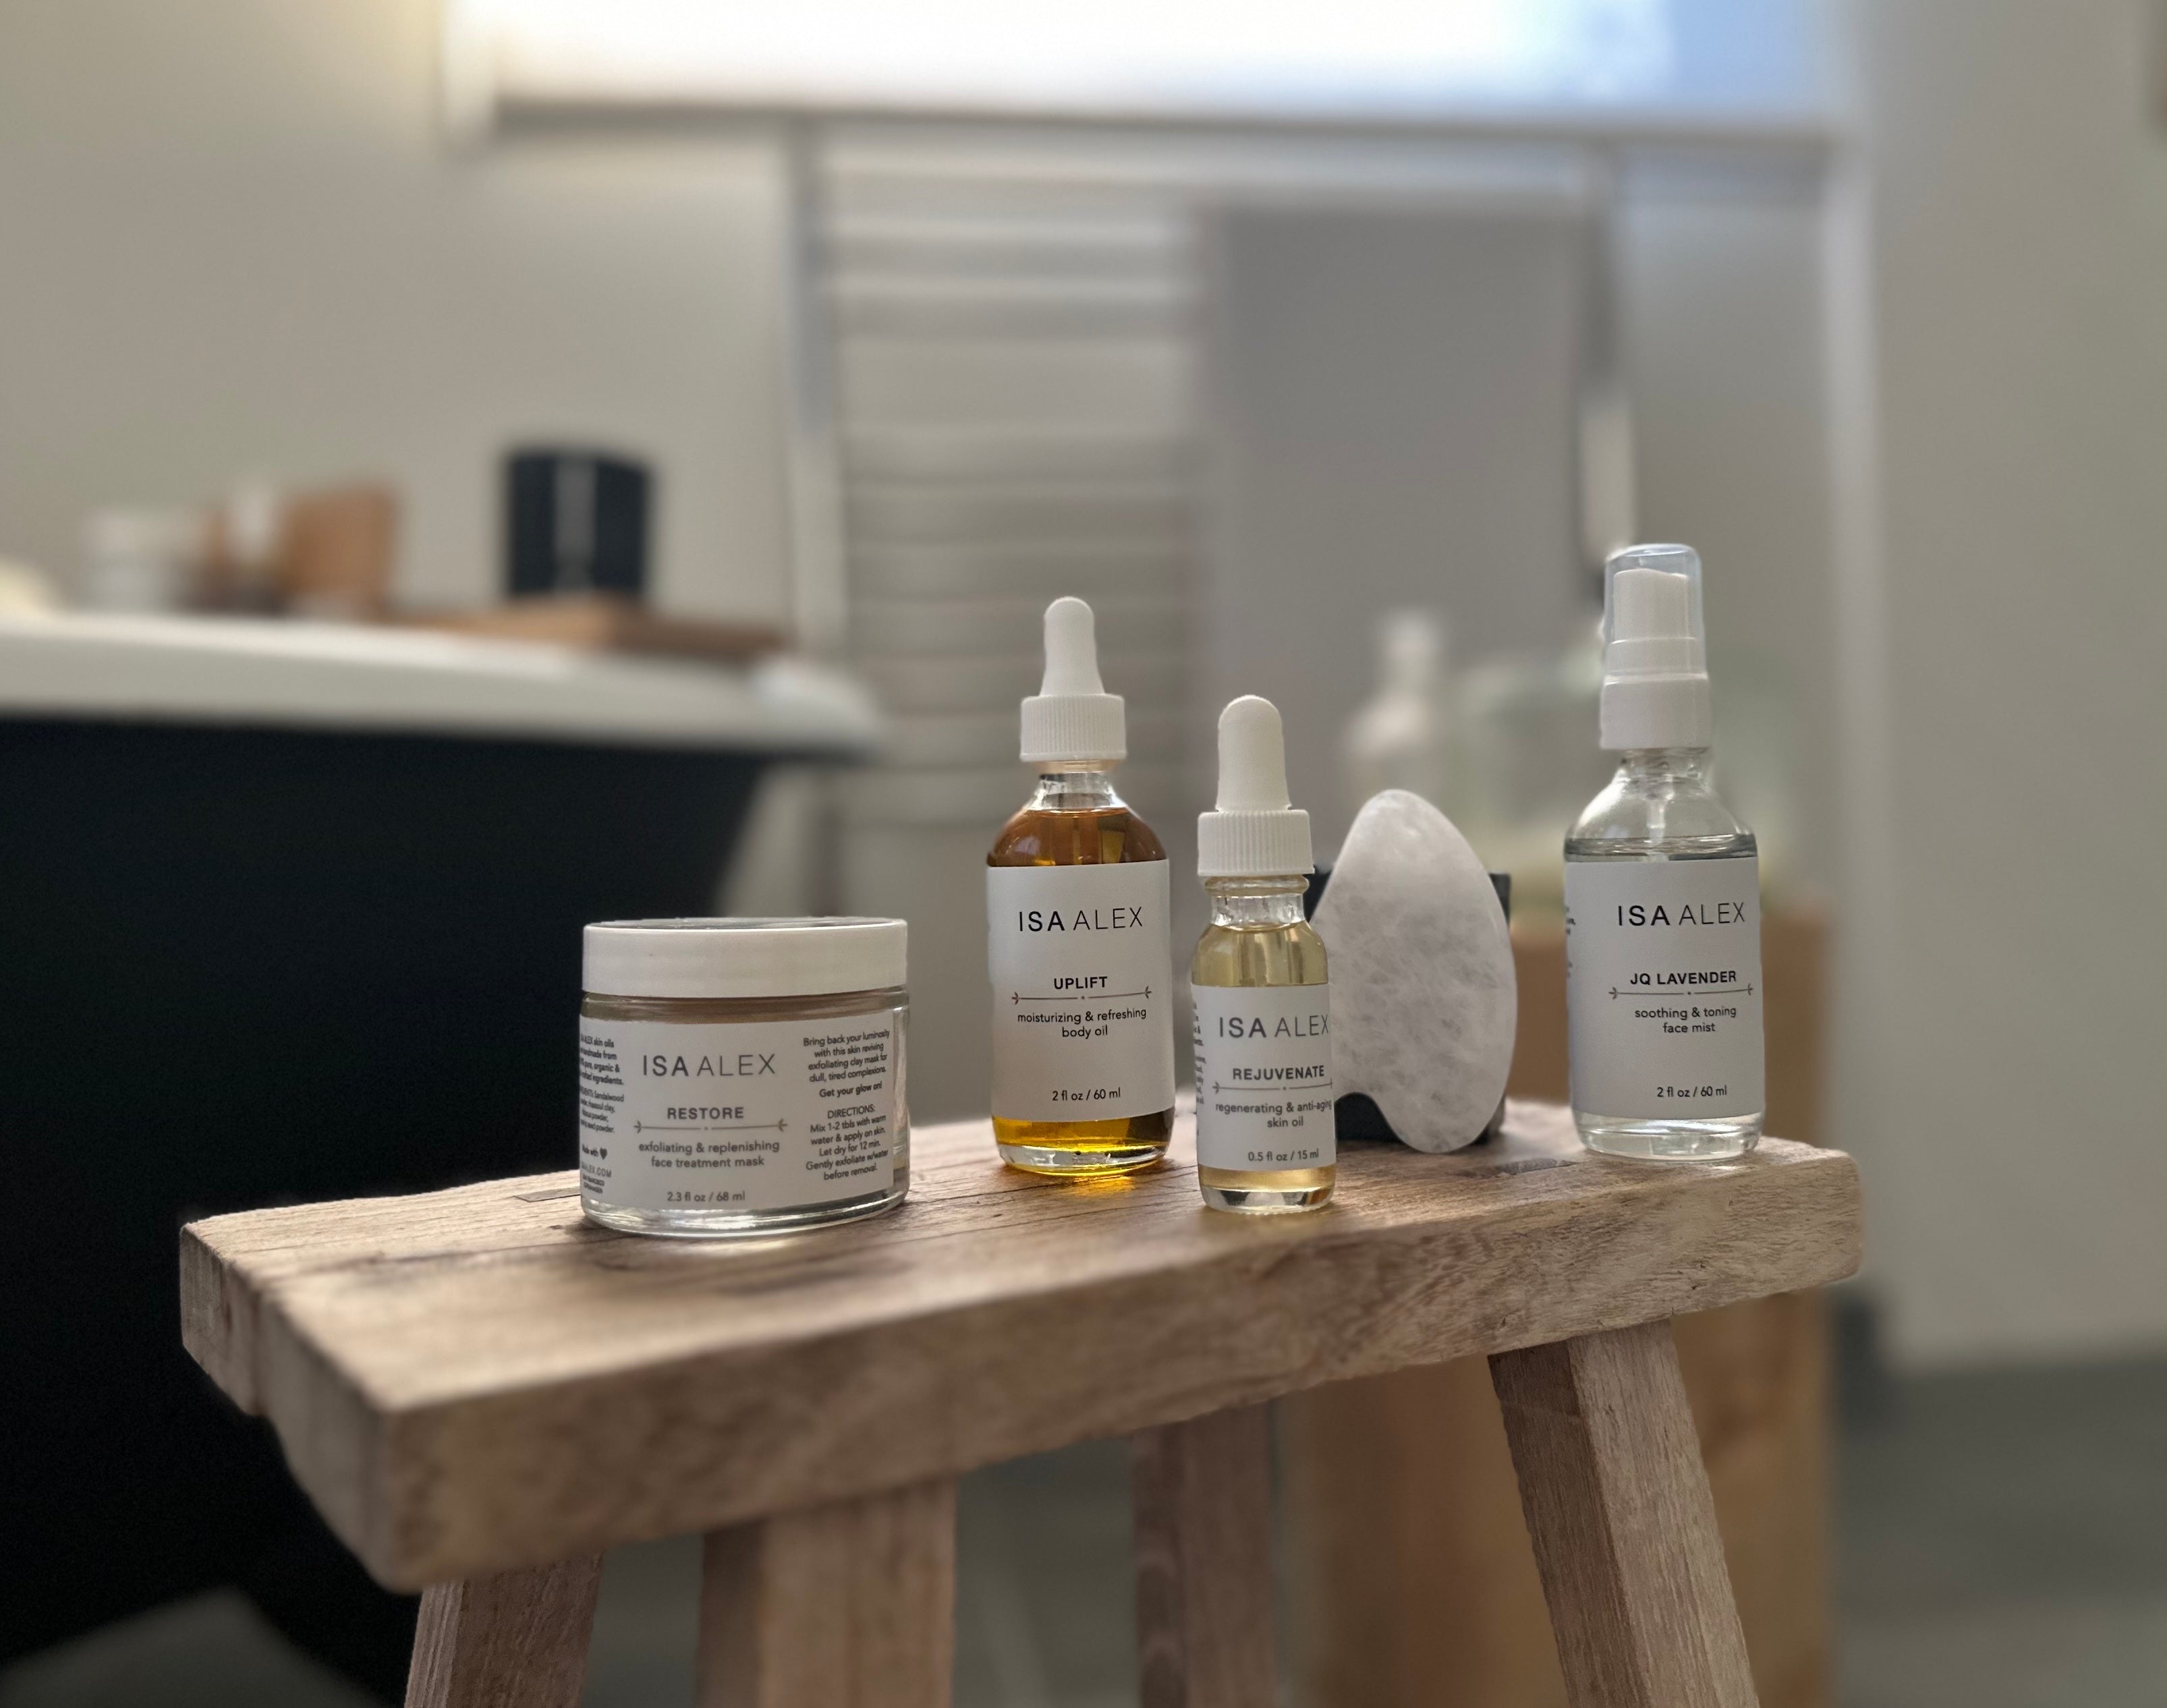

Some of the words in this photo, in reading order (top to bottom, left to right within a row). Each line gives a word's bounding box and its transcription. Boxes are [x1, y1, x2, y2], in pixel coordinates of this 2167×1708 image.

[1019, 911, 1065, 932] ISA
[1073, 906, 1144, 931] ALEX
[1618, 905, 1670, 927] ISA
[1679, 902, 1746, 926] ALEX
[1053, 976, 1108, 990] UPLIFT
[1630, 973, 1652, 986] JQ
[1657, 970, 1737, 985] LAVENDER
[1017, 1012, 1081, 1024] moisturizing
[1085, 1011, 1094, 1022] &
[1097, 1008, 1147, 1021] refreshing
[1635, 1007, 1688, 1021] soothing
[1691, 1007, 1701, 1018] &
[1704, 1006, 1737, 1018] toning
[1062, 1027, 1092, 1040] body
[1094, 1025, 1108, 1036] oil
[1219, 1017, 1266, 1037] ISA
[1274, 1014, 1329, 1037] ALEX
[1663, 1022, 1688, 1033] face
[1692, 1021, 1716, 1033] mist
[804, 1037, 825, 1047] Bring
[827, 1034, 845, 1044] back
[847, 1035, 862, 1044] your
[863, 1029, 890, 1040] luminosity
[814, 1048, 831, 1058] with
[833, 1047, 845, 1056] this
[847, 1046, 860, 1054] skin
[862, 1043, 884, 1052] reviving
[594, 1062, 614, 1073] organic
[615, 1064, 620, 1073] &
[643, 1055, 689, 1077] ISA
[697, 1053, 775, 1077] ALEX
[808, 1059, 849, 1070] exfoliating
[851, 1058, 863, 1067] clay
[865, 1054, 879, 1063] mask
[810, 1073, 826, 1082] dull,
[828, 1070, 846, 1081] tired
[1233, 1065, 1325, 1081] REJUVENATE
[820, 1089, 835, 1097] Get
[837, 1087, 854, 1098] your
[855, 1083, 872, 1095] glow
[1052, 1091, 1059, 1102] 2
[1061, 1090, 1068, 1101] fl
[1071, 1092, 1083, 1101] oz
[1086, 1089, 1091, 1102] /
[1094, 1089, 1106, 1100] 60
[1109, 1087, 1121, 1099] ml
[1657, 1087, 1664, 1098] 2
[1666, 1086, 1674, 1098] fl
[1677, 1088, 1690, 1098] oz
[1693, 1085, 1697, 1098] /
[1700, 1085, 1714, 1097] 60
[1716, 1085, 1727, 1096] ml
[667, 1107, 744, 1120] RESTORE
[1215, 1102, 1283, 1114] regenerating
[1287, 1102, 1294, 1112] &
[1297, 1100, 1332, 1112] anti-aging
[810, 1124, 826, 1133] Mix
[828, 1121, 840, 1131] 1-2
[842, 1119, 855, 1129] tbls
[856, 1116, 870, 1127] with
[1267, 1117, 1289, 1128] skin
[1291, 1116, 1303, 1127] oil
[811, 1136, 833, 1145] water
[836, 1134, 842, 1142] &
[844, 1131, 864, 1141] apply
[638, 1141, 692, 1156] exfoliating
[696, 1143, 704, 1153] &
[708, 1140, 780, 1154] replenishing
[819, 1148, 832, 1156] Let
[834, 1145, 846, 1155] dry
[860, 1141, 867, 1150] 12
[1247, 1151, 1264, 1162] 0.5
[1266, 1151, 1272, 1160] fl
[1276, 1153, 1288, 1161] oz
[1290, 1151, 1294, 1161] /
[1298, 1150, 1307, 1160] 15
[1310, 1148, 1319, 1159] ml
[651, 1156, 672, 1167] face
[675, 1158, 731, 1168] treatment
[735, 1156, 765, 1166] mask
[806, 1159, 833, 1170] Gently
[835, 1155, 866, 1166] exfoliate
[824, 1170, 849, 1180] before
[667, 1192, 681, 1201] 2.3
[685, 1192, 691, 1201] fl
[708, 1192, 714, 1203] /
[716, 1192, 729, 1201] 68
[733, 1191, 745, 1200] ml
